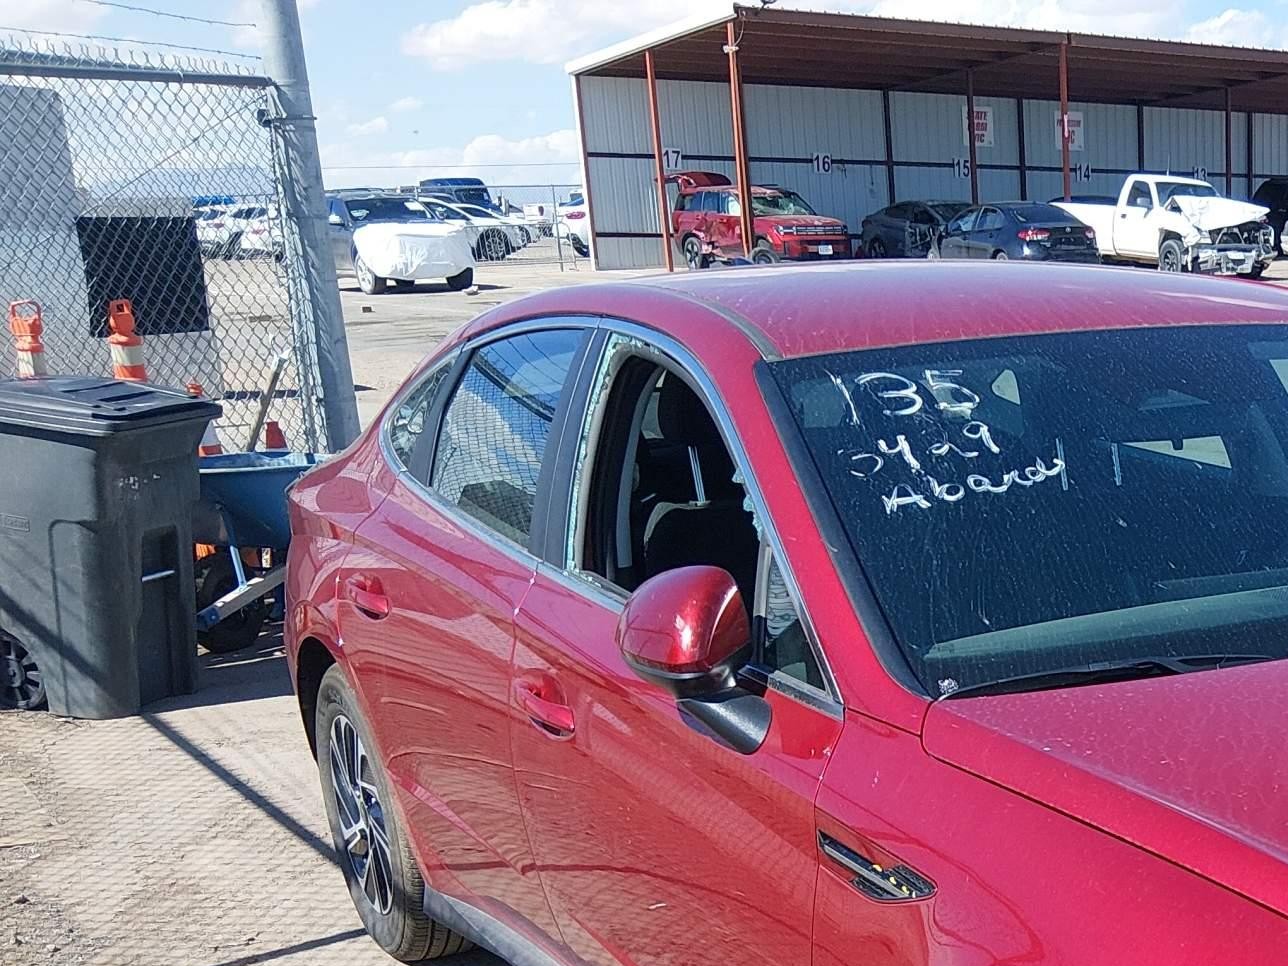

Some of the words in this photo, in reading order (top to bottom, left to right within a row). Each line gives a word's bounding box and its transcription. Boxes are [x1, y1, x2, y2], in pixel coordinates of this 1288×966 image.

[663, 150, 681, 169] 17
[813, 153, 831, 173] 16
[954, 160, 970, 178] 15
[1076, 164, 1091, 182] 14
